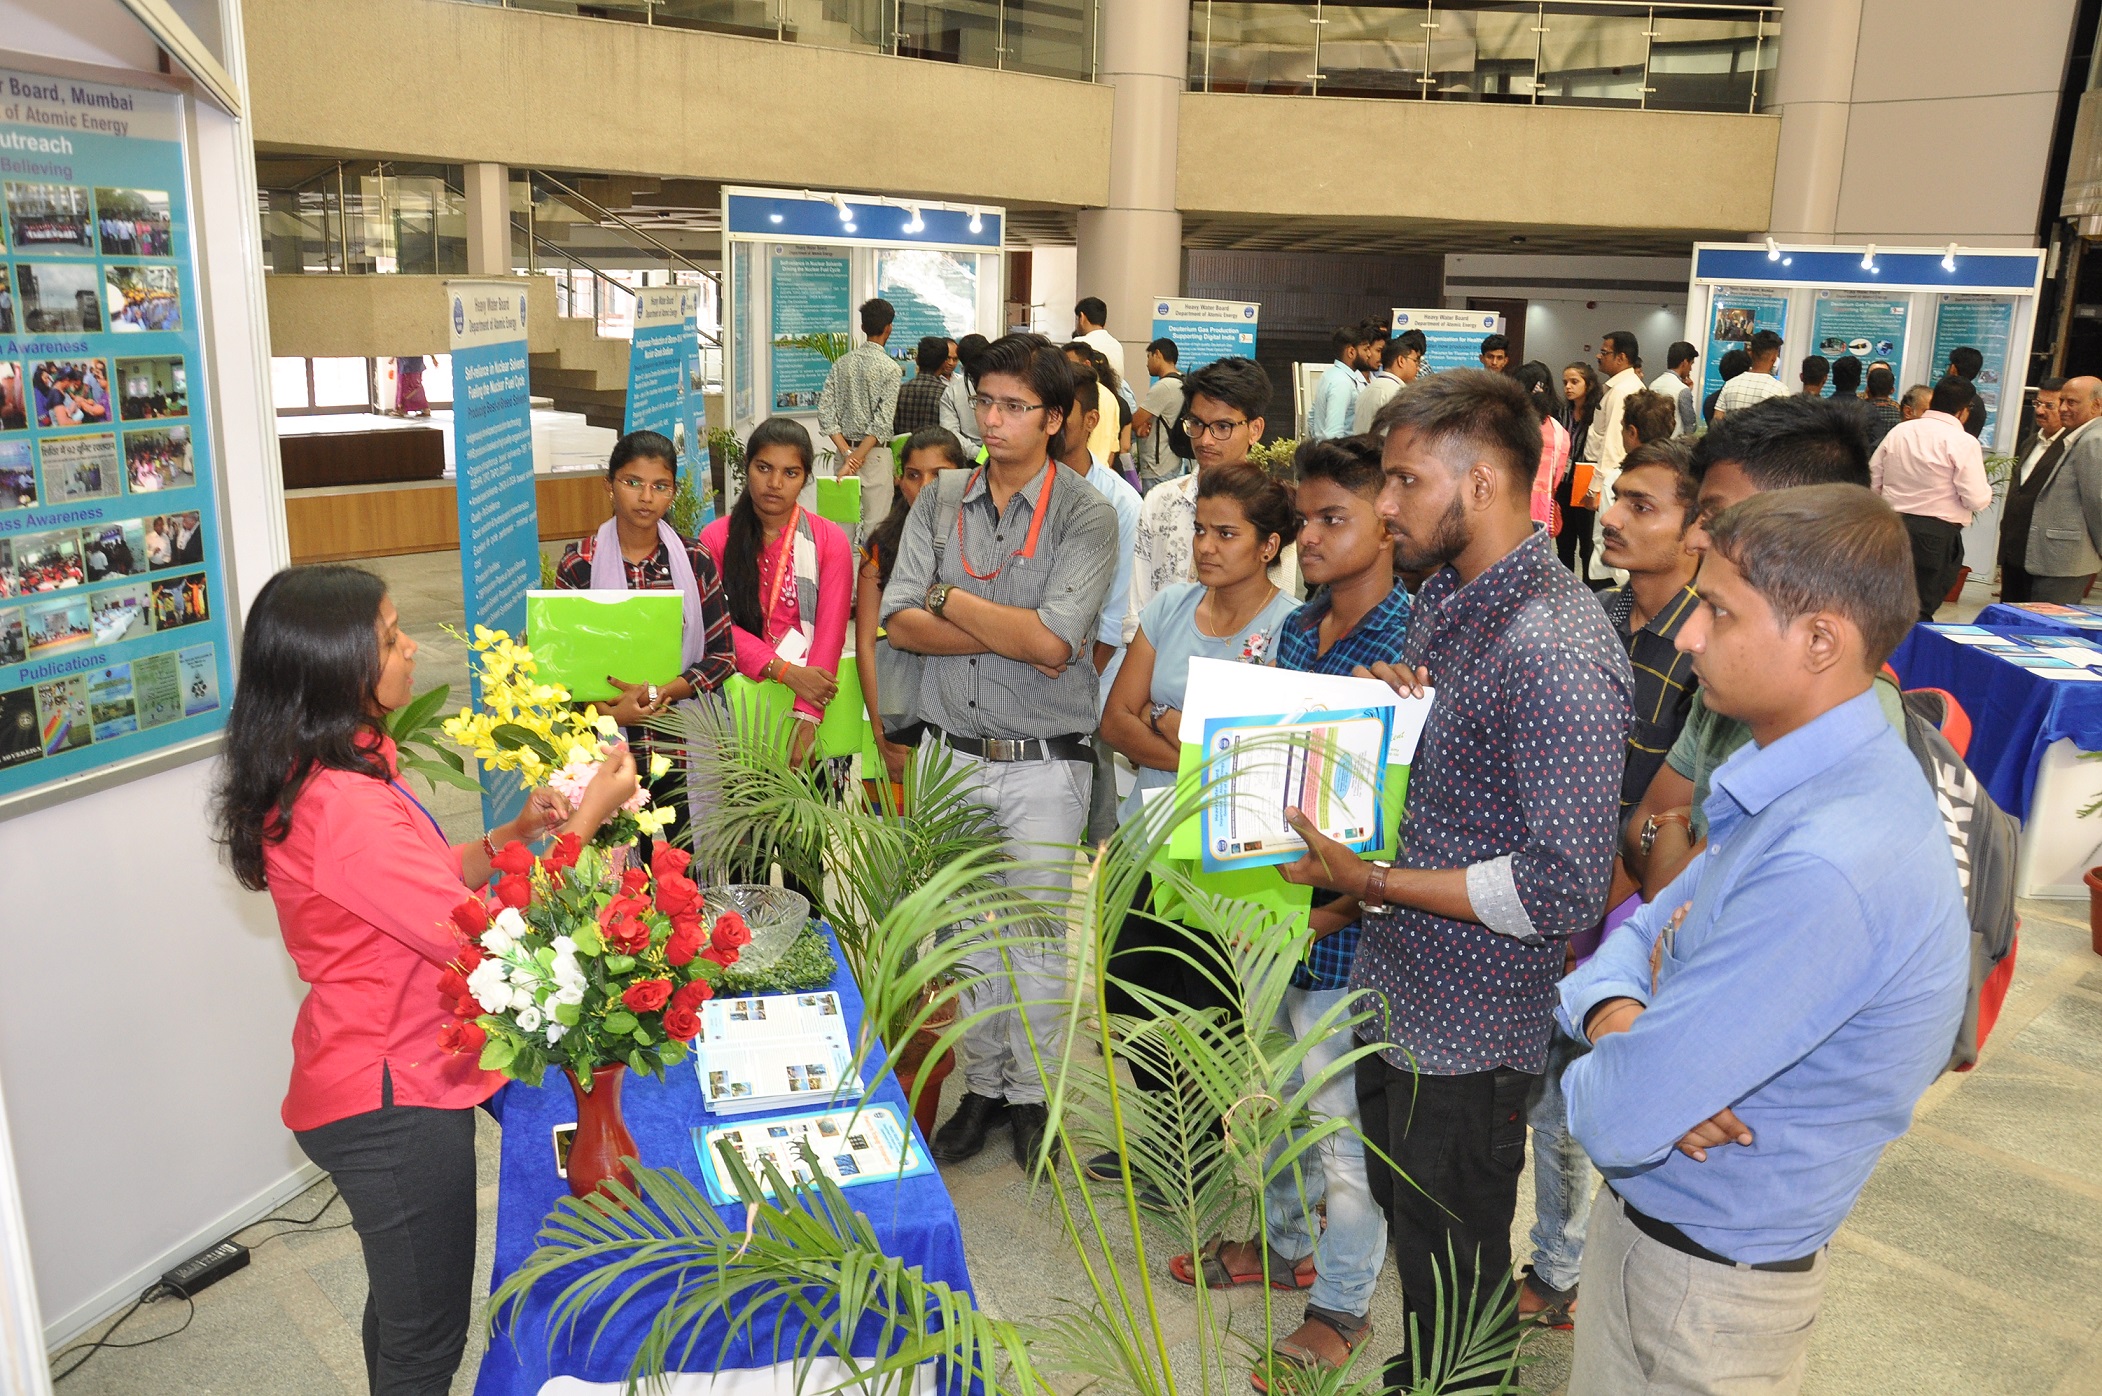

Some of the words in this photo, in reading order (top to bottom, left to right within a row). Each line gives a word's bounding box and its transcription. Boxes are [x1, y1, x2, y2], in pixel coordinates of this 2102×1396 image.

[9, 77, 66, 105] Board,
[70, 86, 134, 111] Mumbai
[5, 104, 19, 120] of
[26, 106, 78, 128] Atomic
[81, 113, 128, 137] Energy
[0, 156, 73, 181] Believing
[1209, 326, 1239, 334] Production
[1414, 320, 1440, 328] Department
[8, 340, 88, 354] Awareness
[1172, 333, 1203, 341] Supporting
[26, 508, 103, 528] Awareness
[20, 653, 107, 682] Publications
